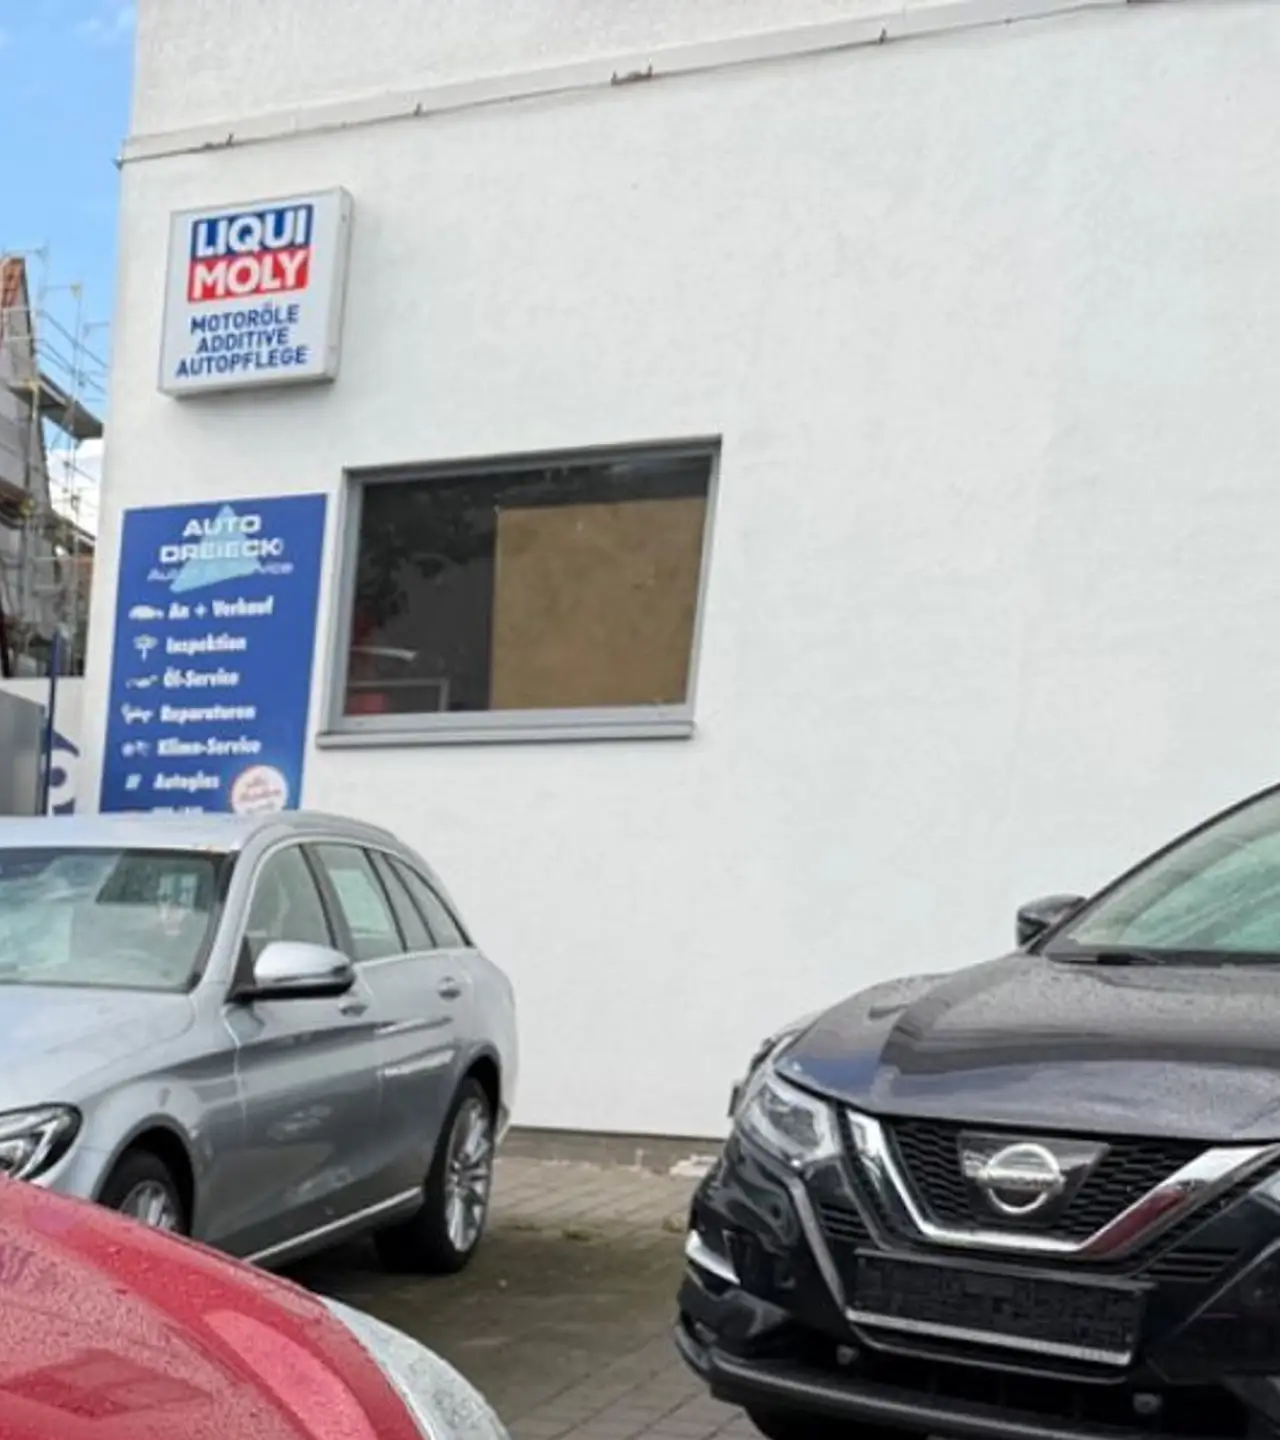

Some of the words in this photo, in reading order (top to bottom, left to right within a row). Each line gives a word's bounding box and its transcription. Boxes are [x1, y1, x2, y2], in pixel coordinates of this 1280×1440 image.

[195, 207, 307, 257] LIQUI
[192, 251, 307, 299] MOLY
[196, 327, 290, 354] ADDITIVE
[176, 347, 308, 378] AUTOPFLEGE
[182, 513, 262, 538] AUTO
[159, 537, 284, 564] DREIECK
[168, 602, 190, 620] An
[212, 595, 274, 618] Verkauf
[166, 632, 246, 656] Inspektion
